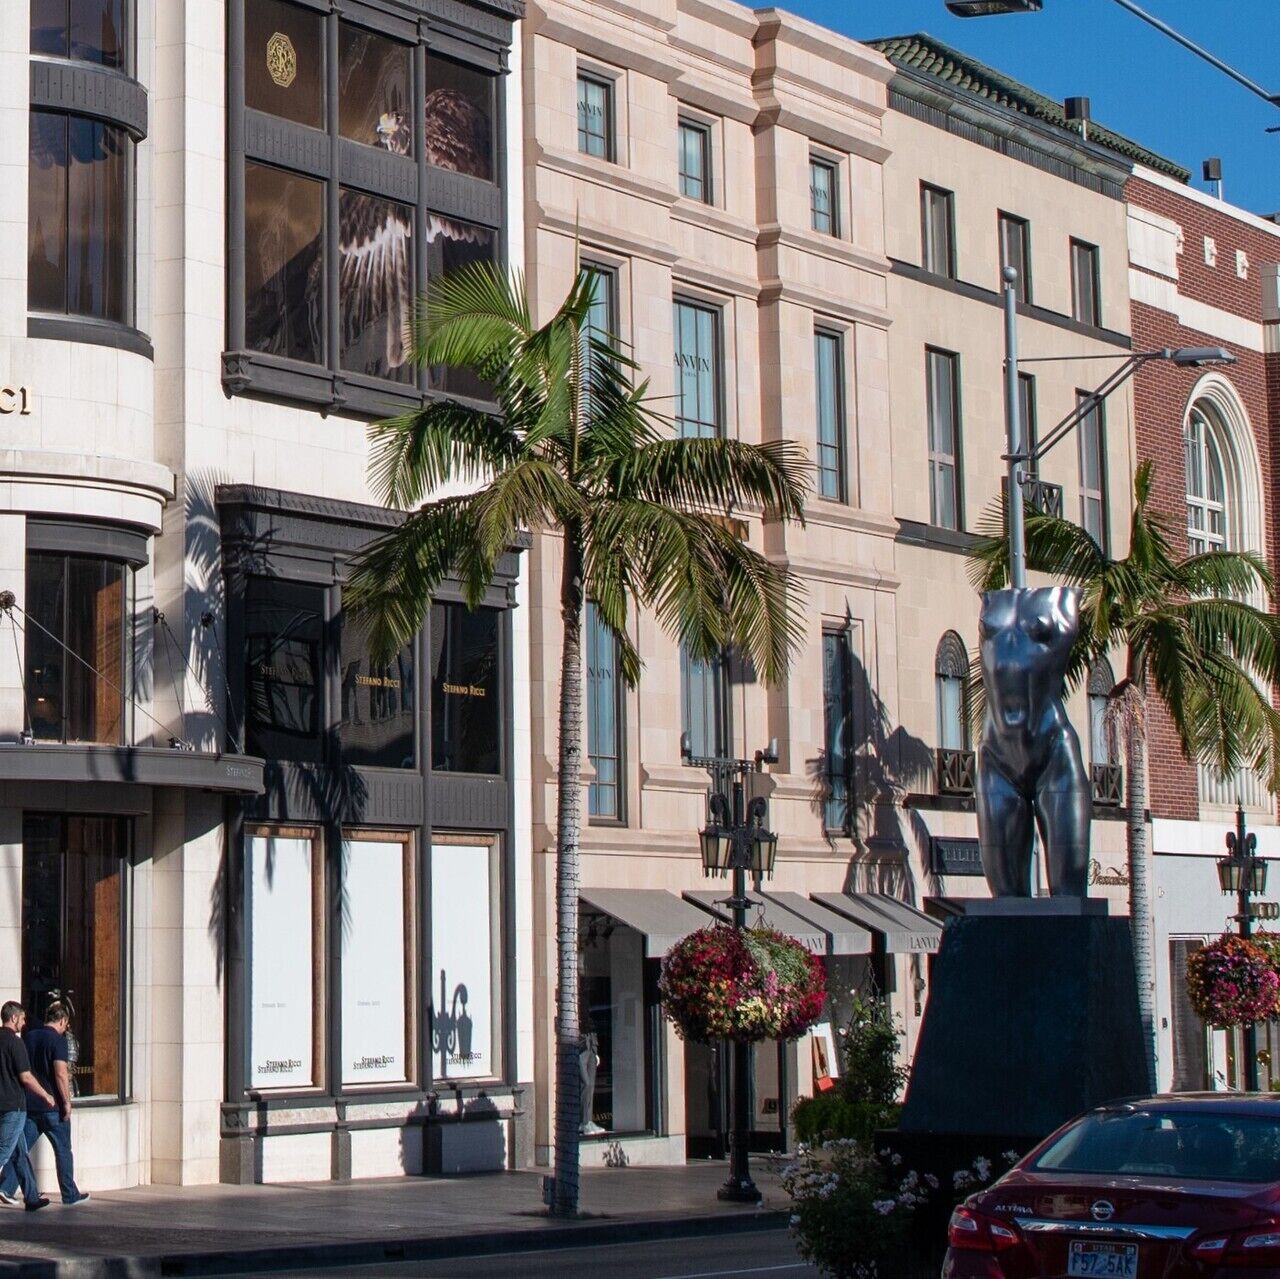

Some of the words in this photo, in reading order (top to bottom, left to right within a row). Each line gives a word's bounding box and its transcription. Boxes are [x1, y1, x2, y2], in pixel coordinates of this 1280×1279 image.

[354, 674, 382, 688] STEFANO
[383, 676, 400, 689] RICCI
[442, 683, 469, 696] STEFANO
[470, 685, 486, 697] RICCI
[288, 1059, 302, 1068] RICCI
[382, 1055, 394, 1064] RICCI
[994, 1204, 1033, 1214] ALTIMA
